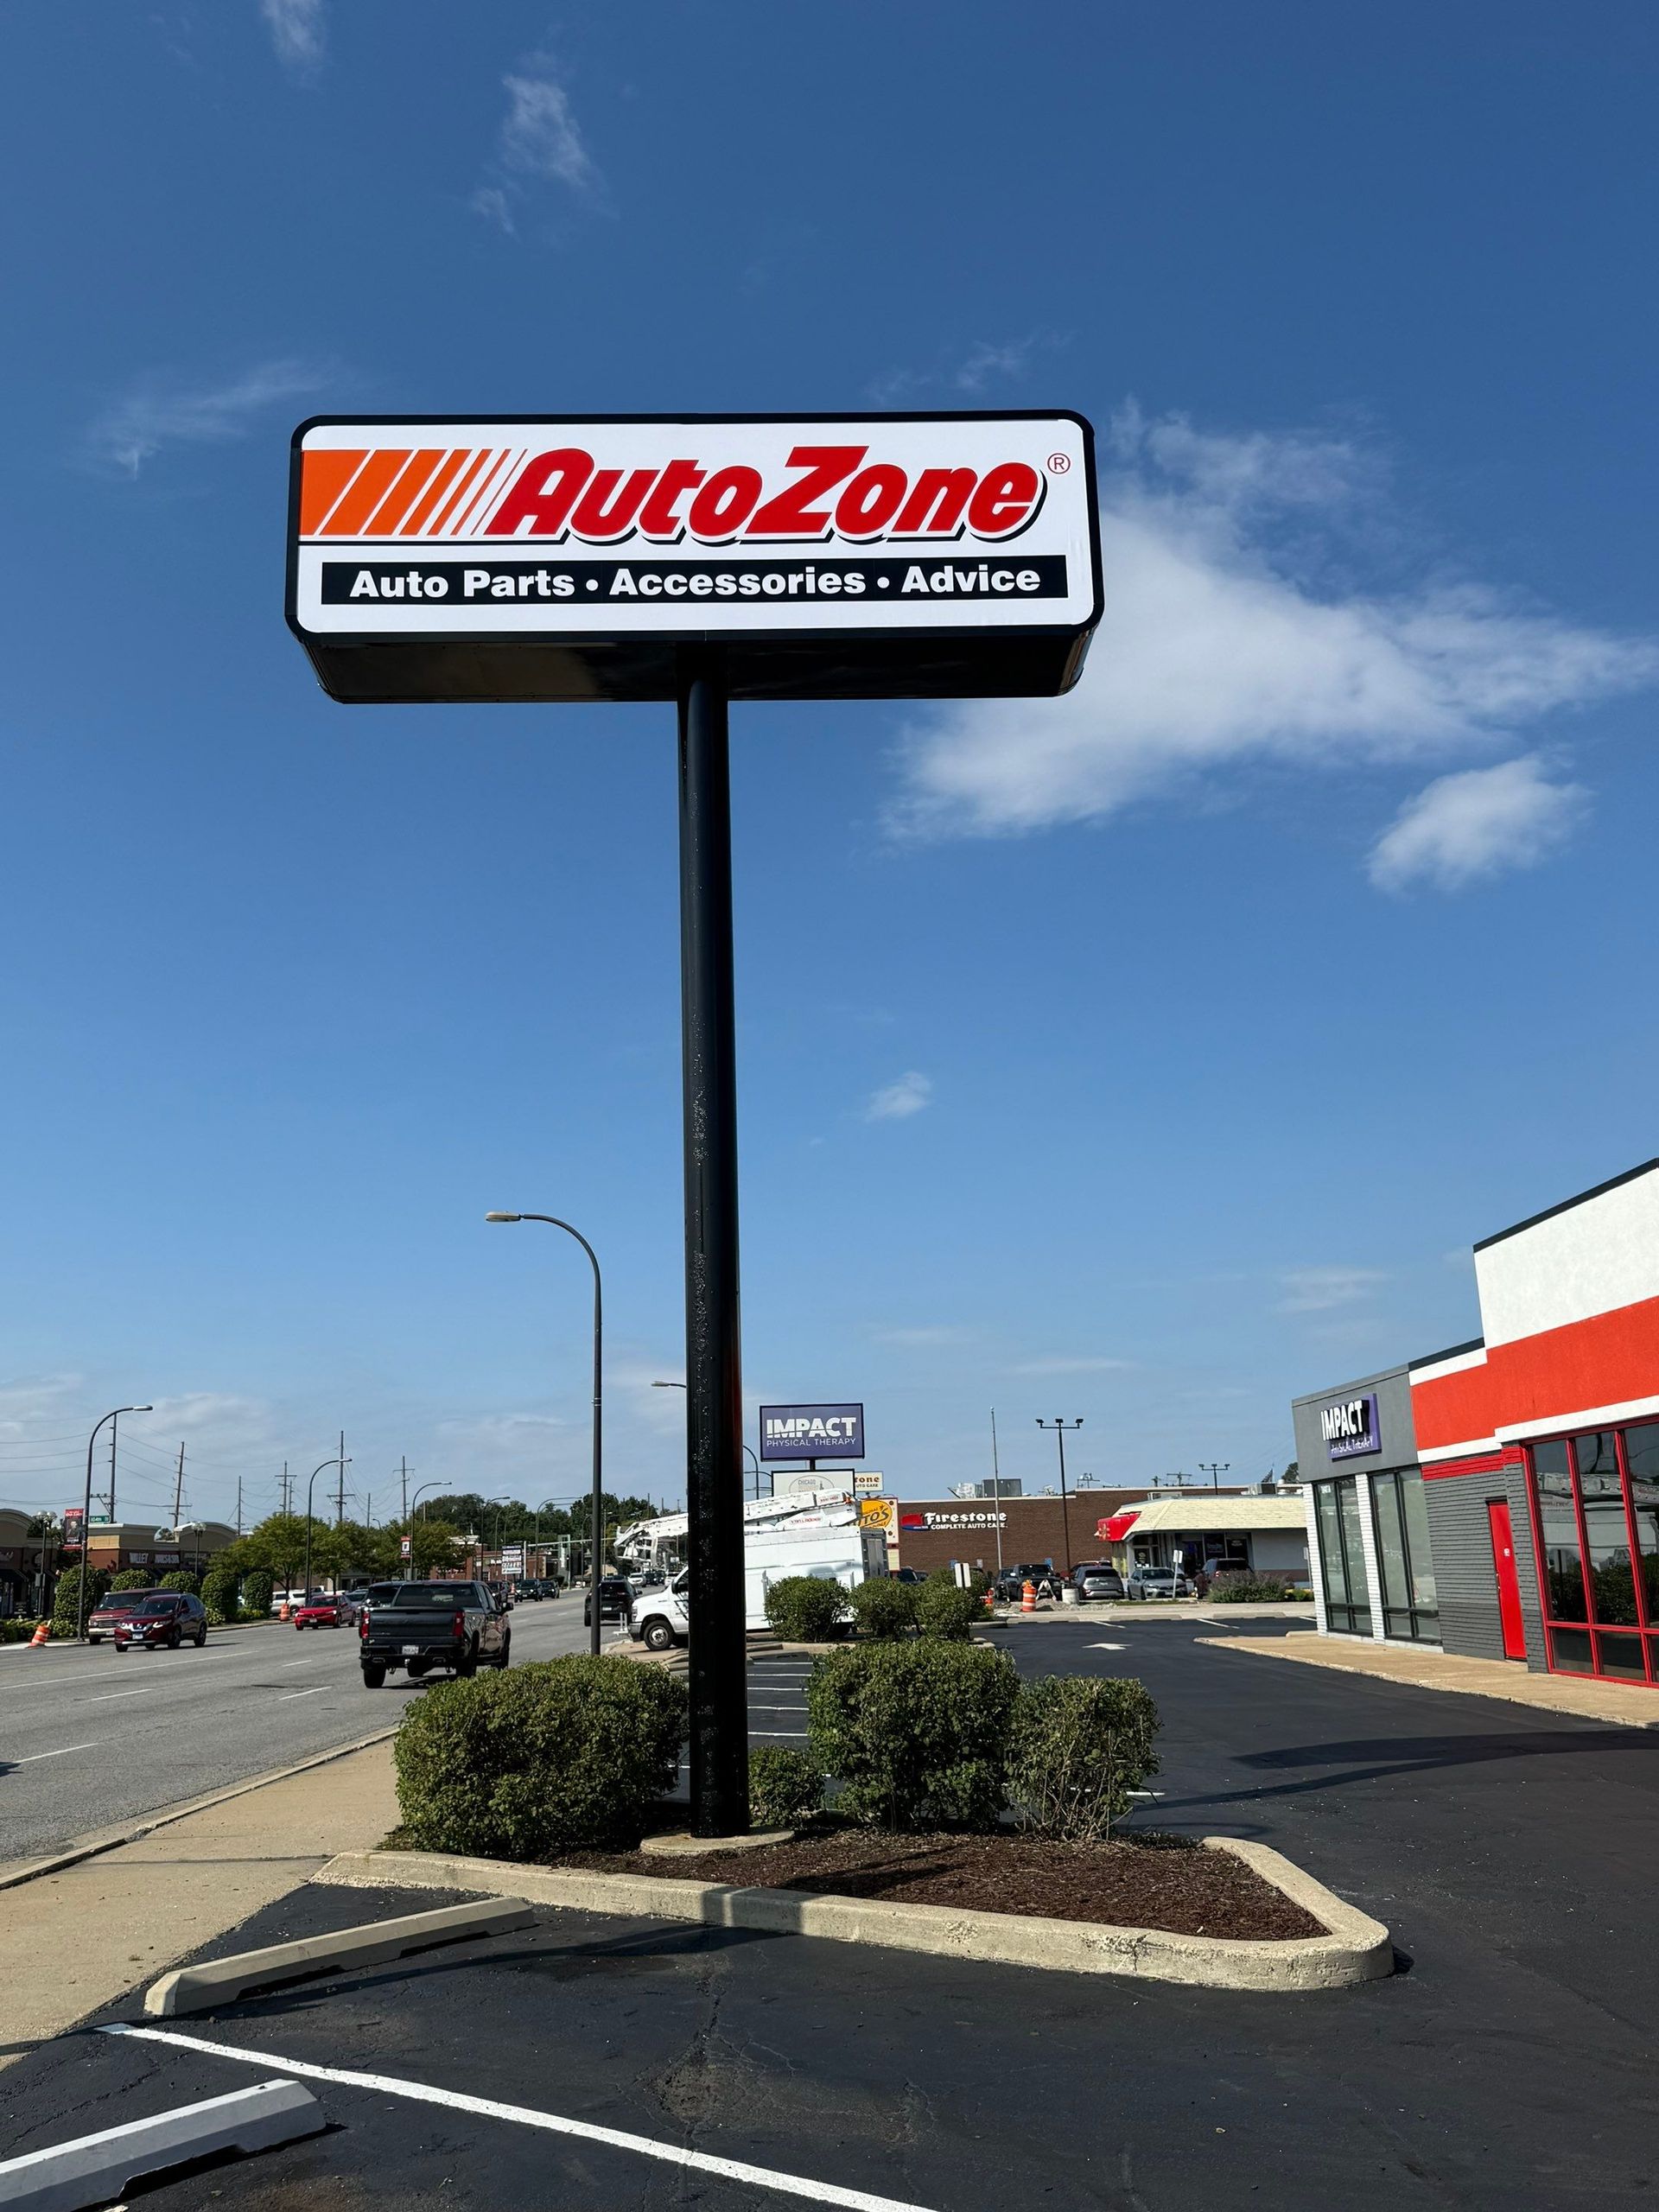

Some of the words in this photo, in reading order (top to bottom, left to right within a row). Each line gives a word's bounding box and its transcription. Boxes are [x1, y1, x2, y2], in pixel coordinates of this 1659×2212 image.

[483, 446, 1042, 539] AutoZone
[349, 570, 448, 598] Auto
[464, 569, 575, 597] Parts
[609, 566, 866, 596] Accessories
[901, 564, 1040, 593] Advice
[766, 1417, 856, 1439] IMPACT
[1320, 1400, 1363, 1441] IMPACT
[766, 1439, 811, 1447] PHYSICAL
[925, 1512, 1007, 1525] Firestone
